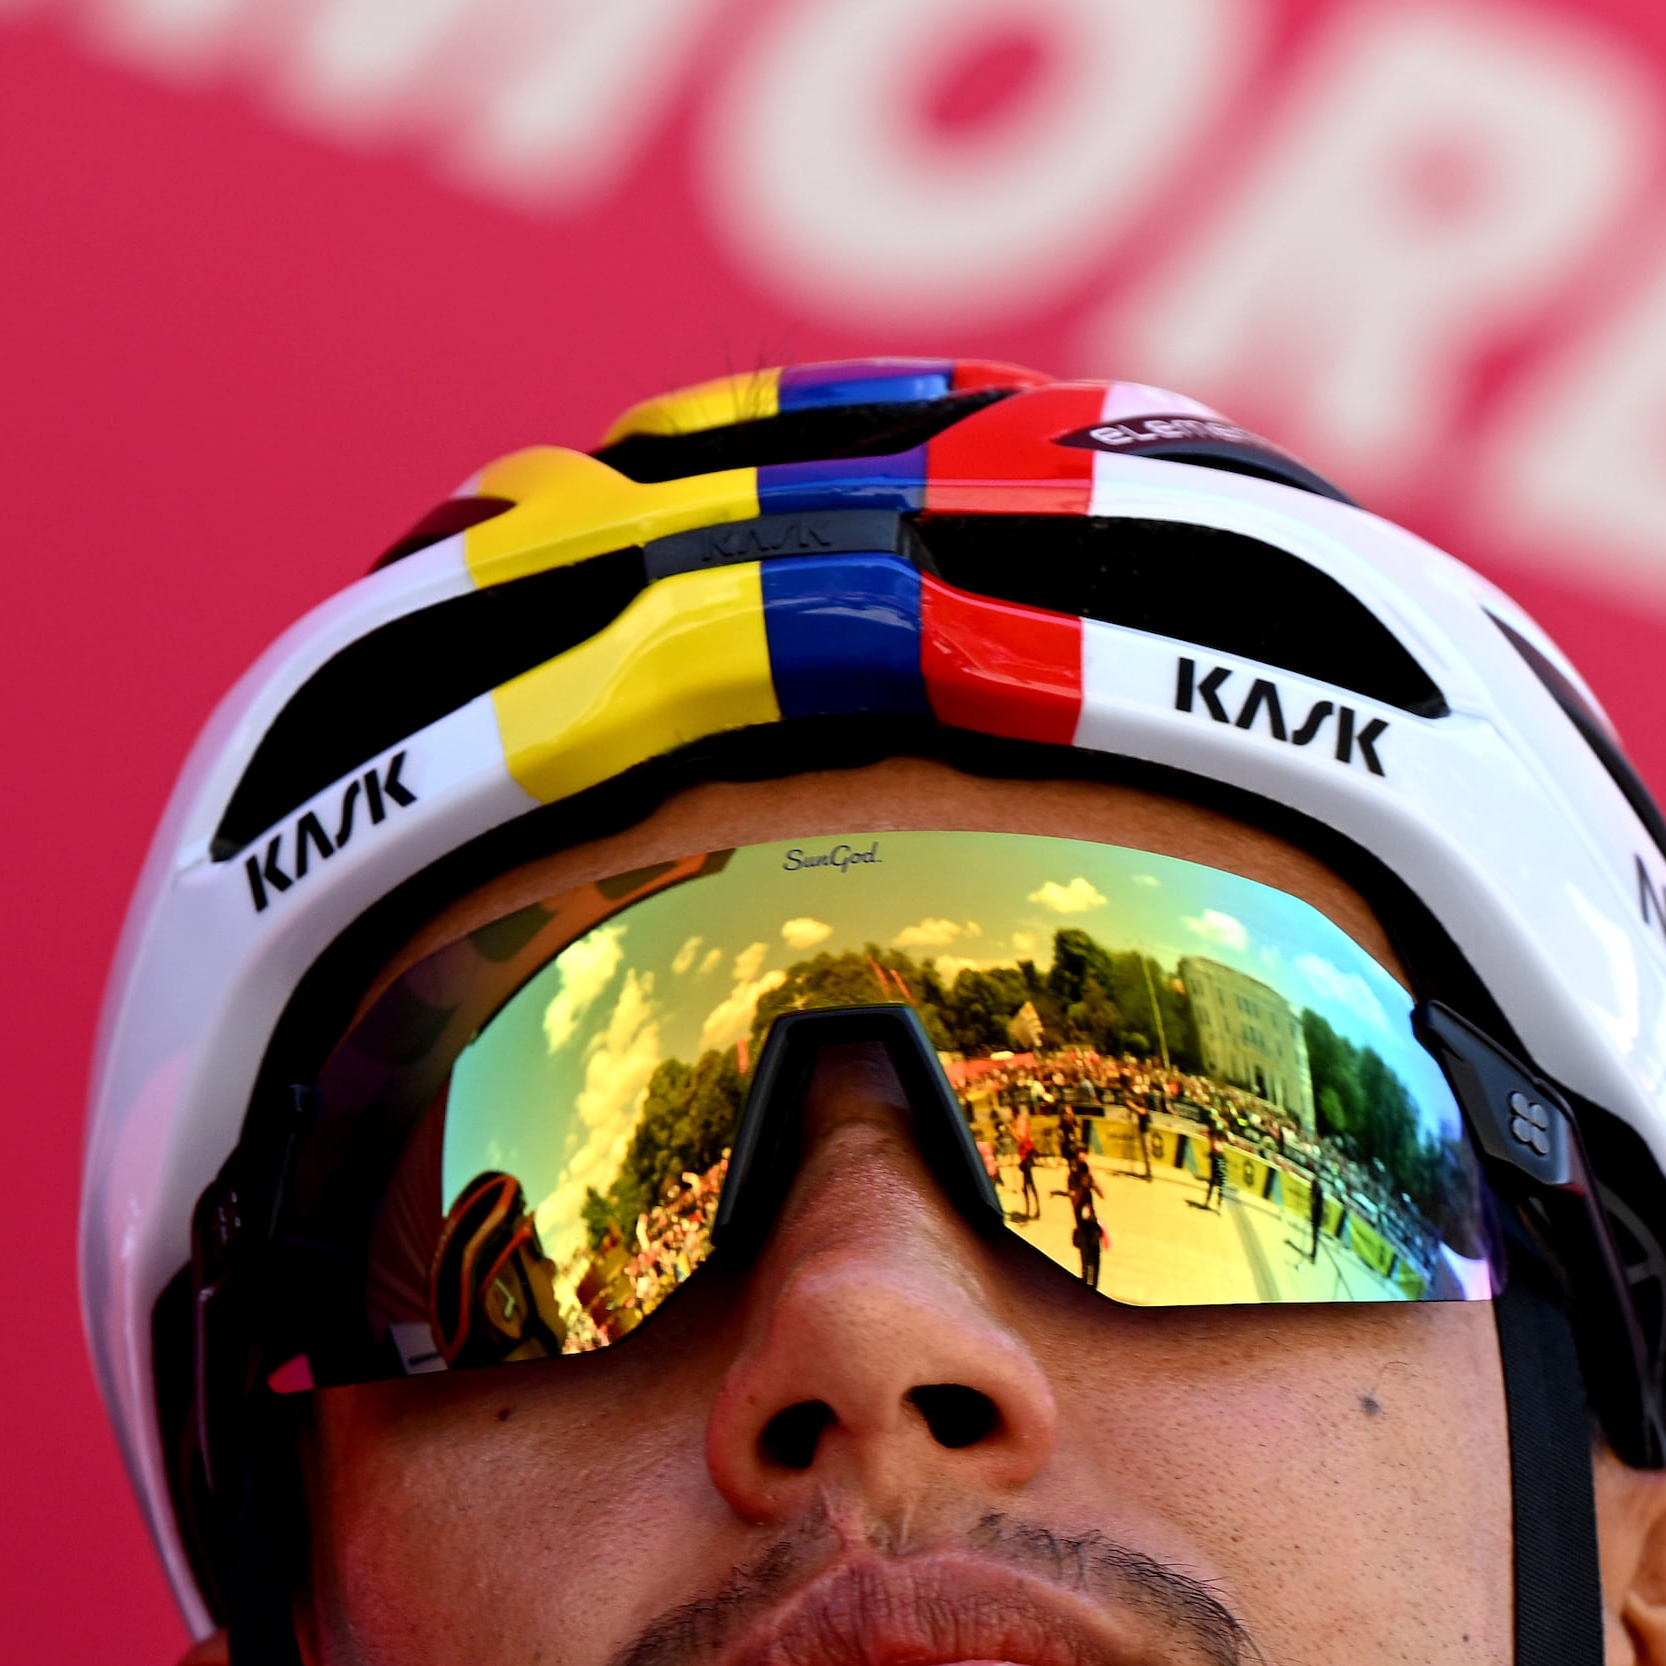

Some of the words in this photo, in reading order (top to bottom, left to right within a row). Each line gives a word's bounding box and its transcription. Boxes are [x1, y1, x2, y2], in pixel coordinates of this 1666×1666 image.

[1174, 656, 1390, 778] KASK
[245, 749, 418, 914] KASK
[782, 841, 883, 873] SunGod
